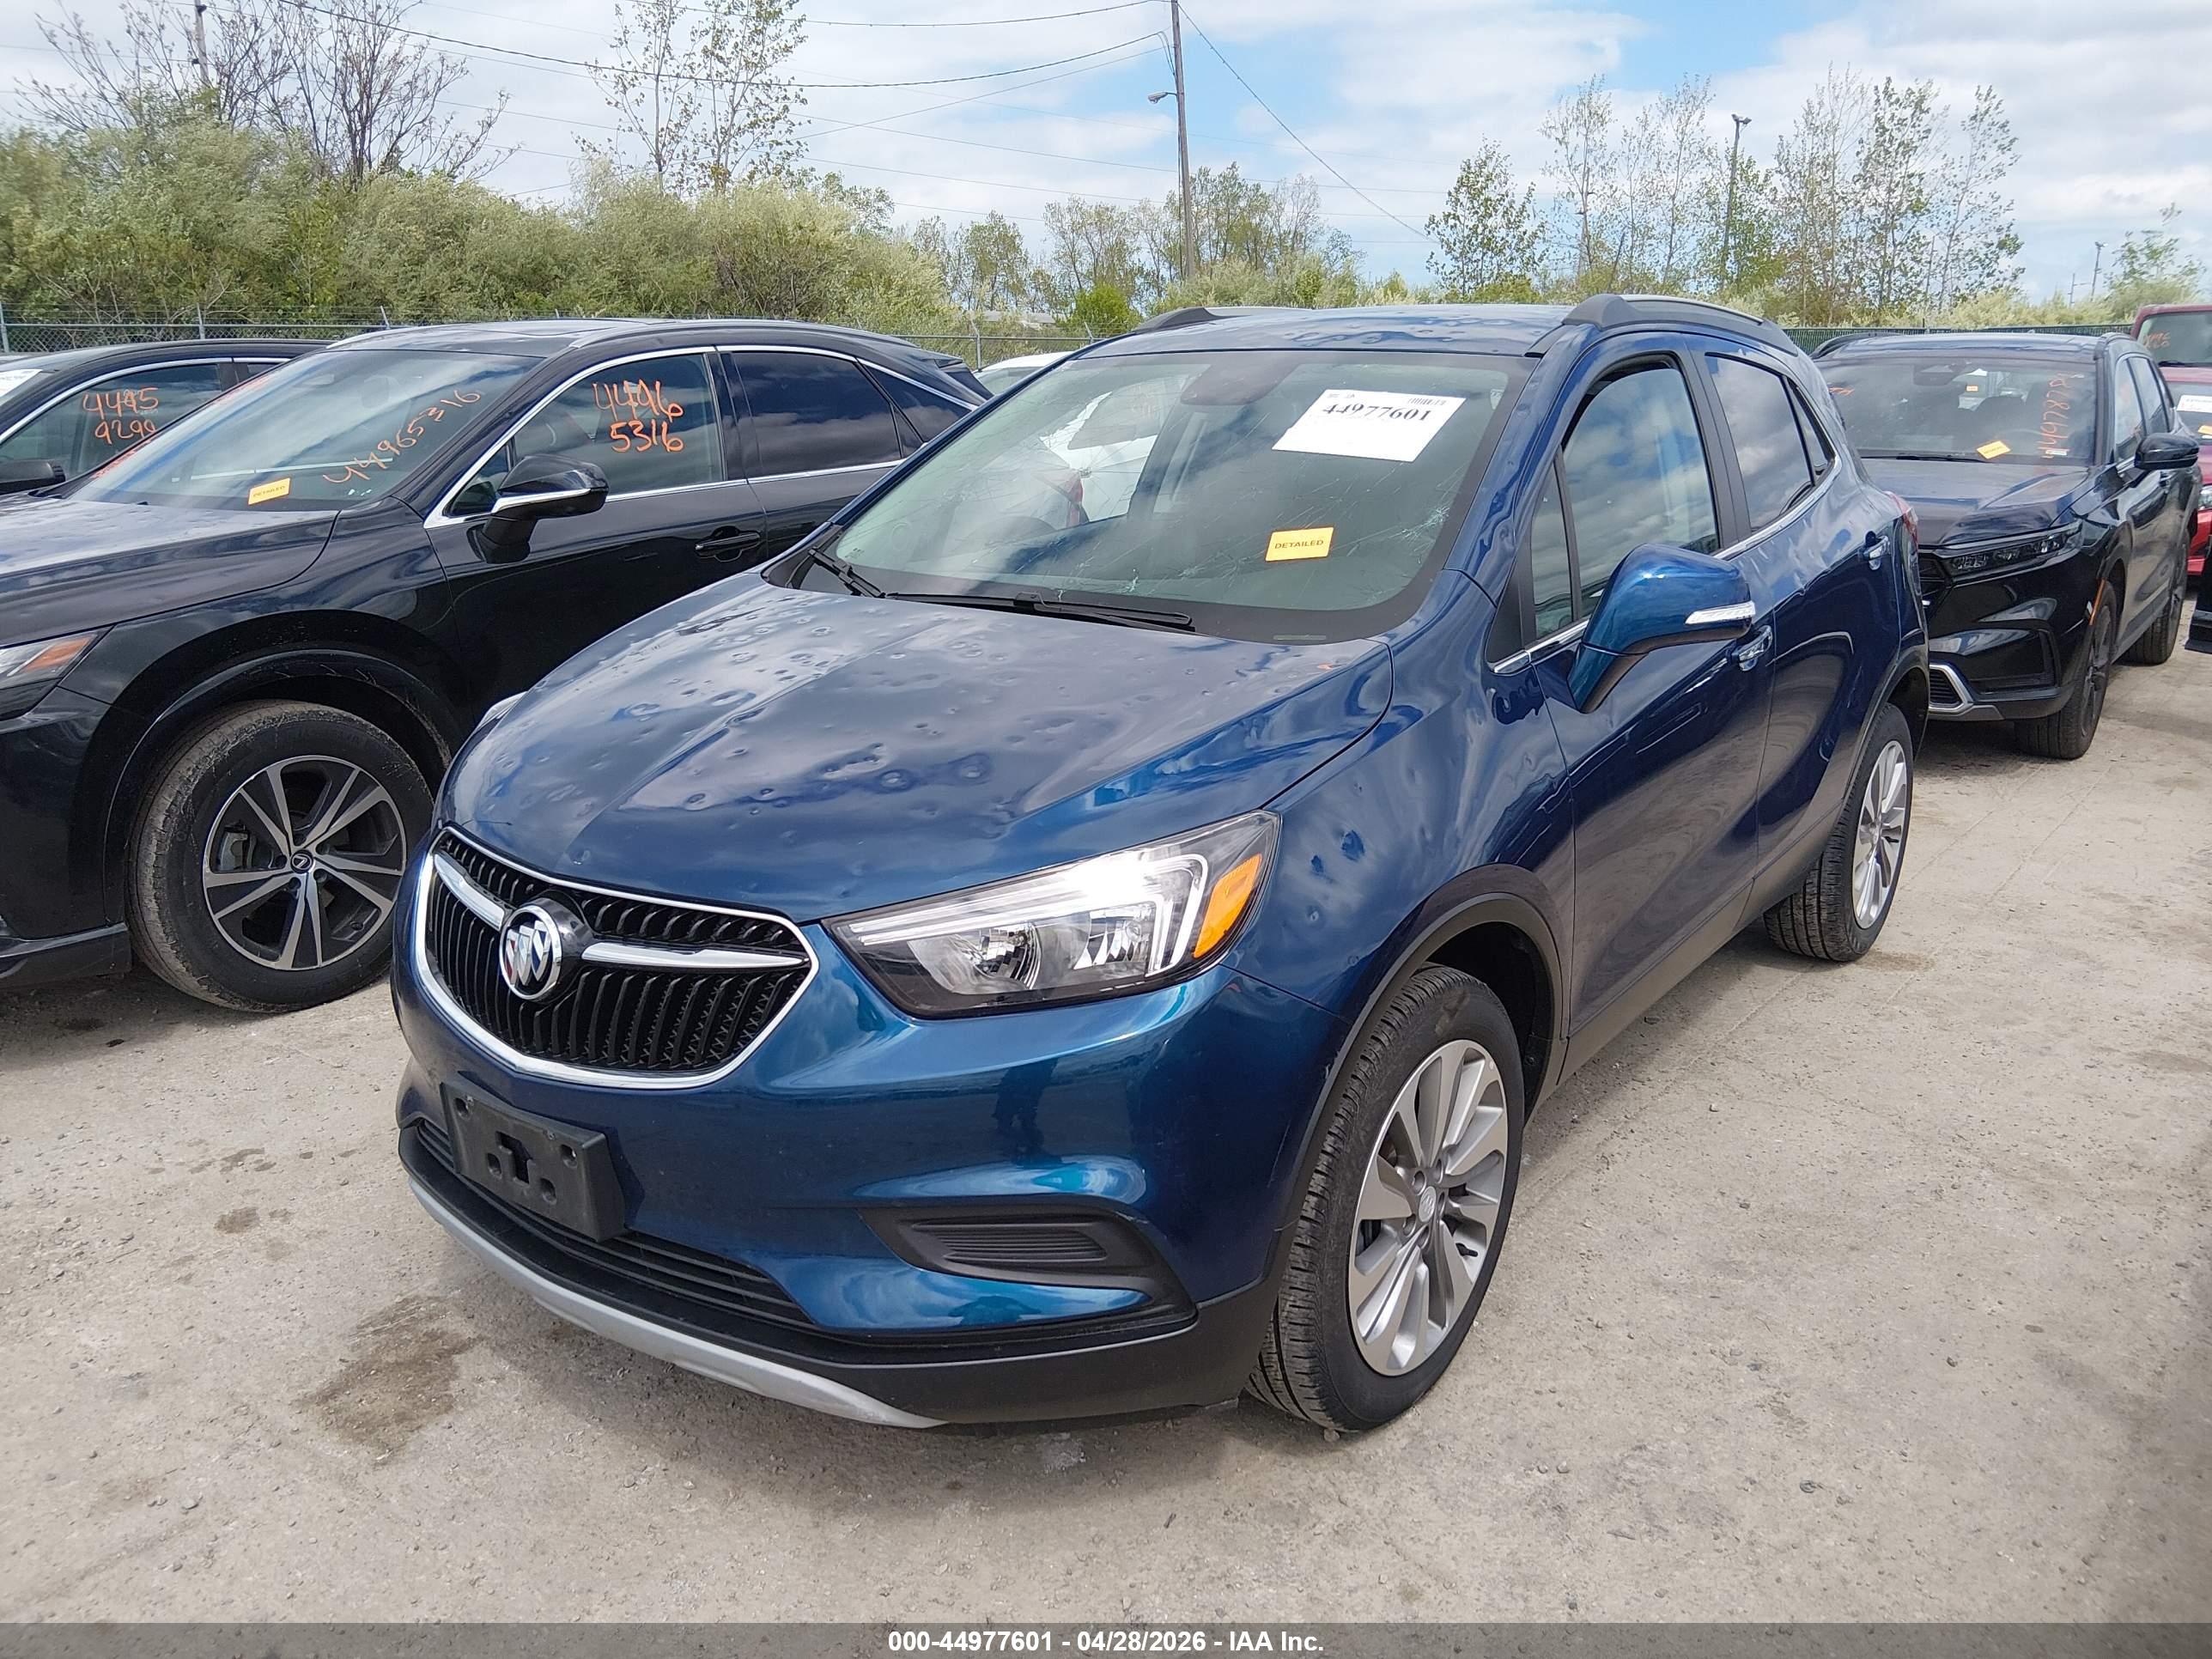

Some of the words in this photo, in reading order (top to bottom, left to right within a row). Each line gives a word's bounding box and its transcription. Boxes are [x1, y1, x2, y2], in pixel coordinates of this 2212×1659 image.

[82, 387, 158, 419] 4495
[592, 379, 684, 422] 4496
[1322, 403, 1431, 421] 44977601
[323, 390, 481, 483] 44965316
[611, 419, 684, 452] 5316
[1274, 539, 1324, 550] DETAILED
